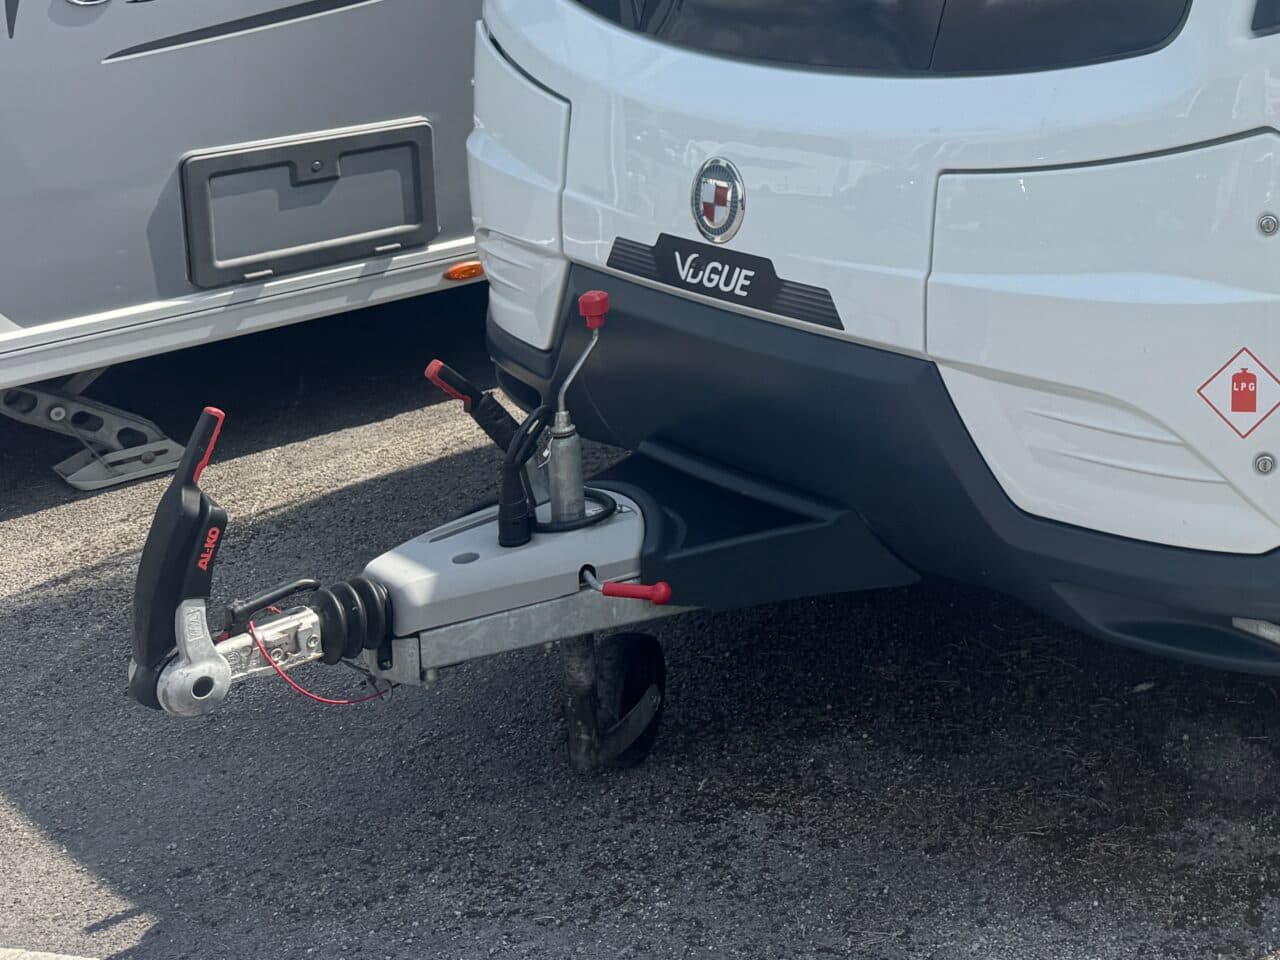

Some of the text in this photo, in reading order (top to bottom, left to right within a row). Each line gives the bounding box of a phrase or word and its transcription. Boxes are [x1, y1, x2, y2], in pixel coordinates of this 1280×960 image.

[674, 251, 755, 297] VOGUE
[1233, 382, 1255, 392] LPG
[197, 527, 220, 571] AL-KO
